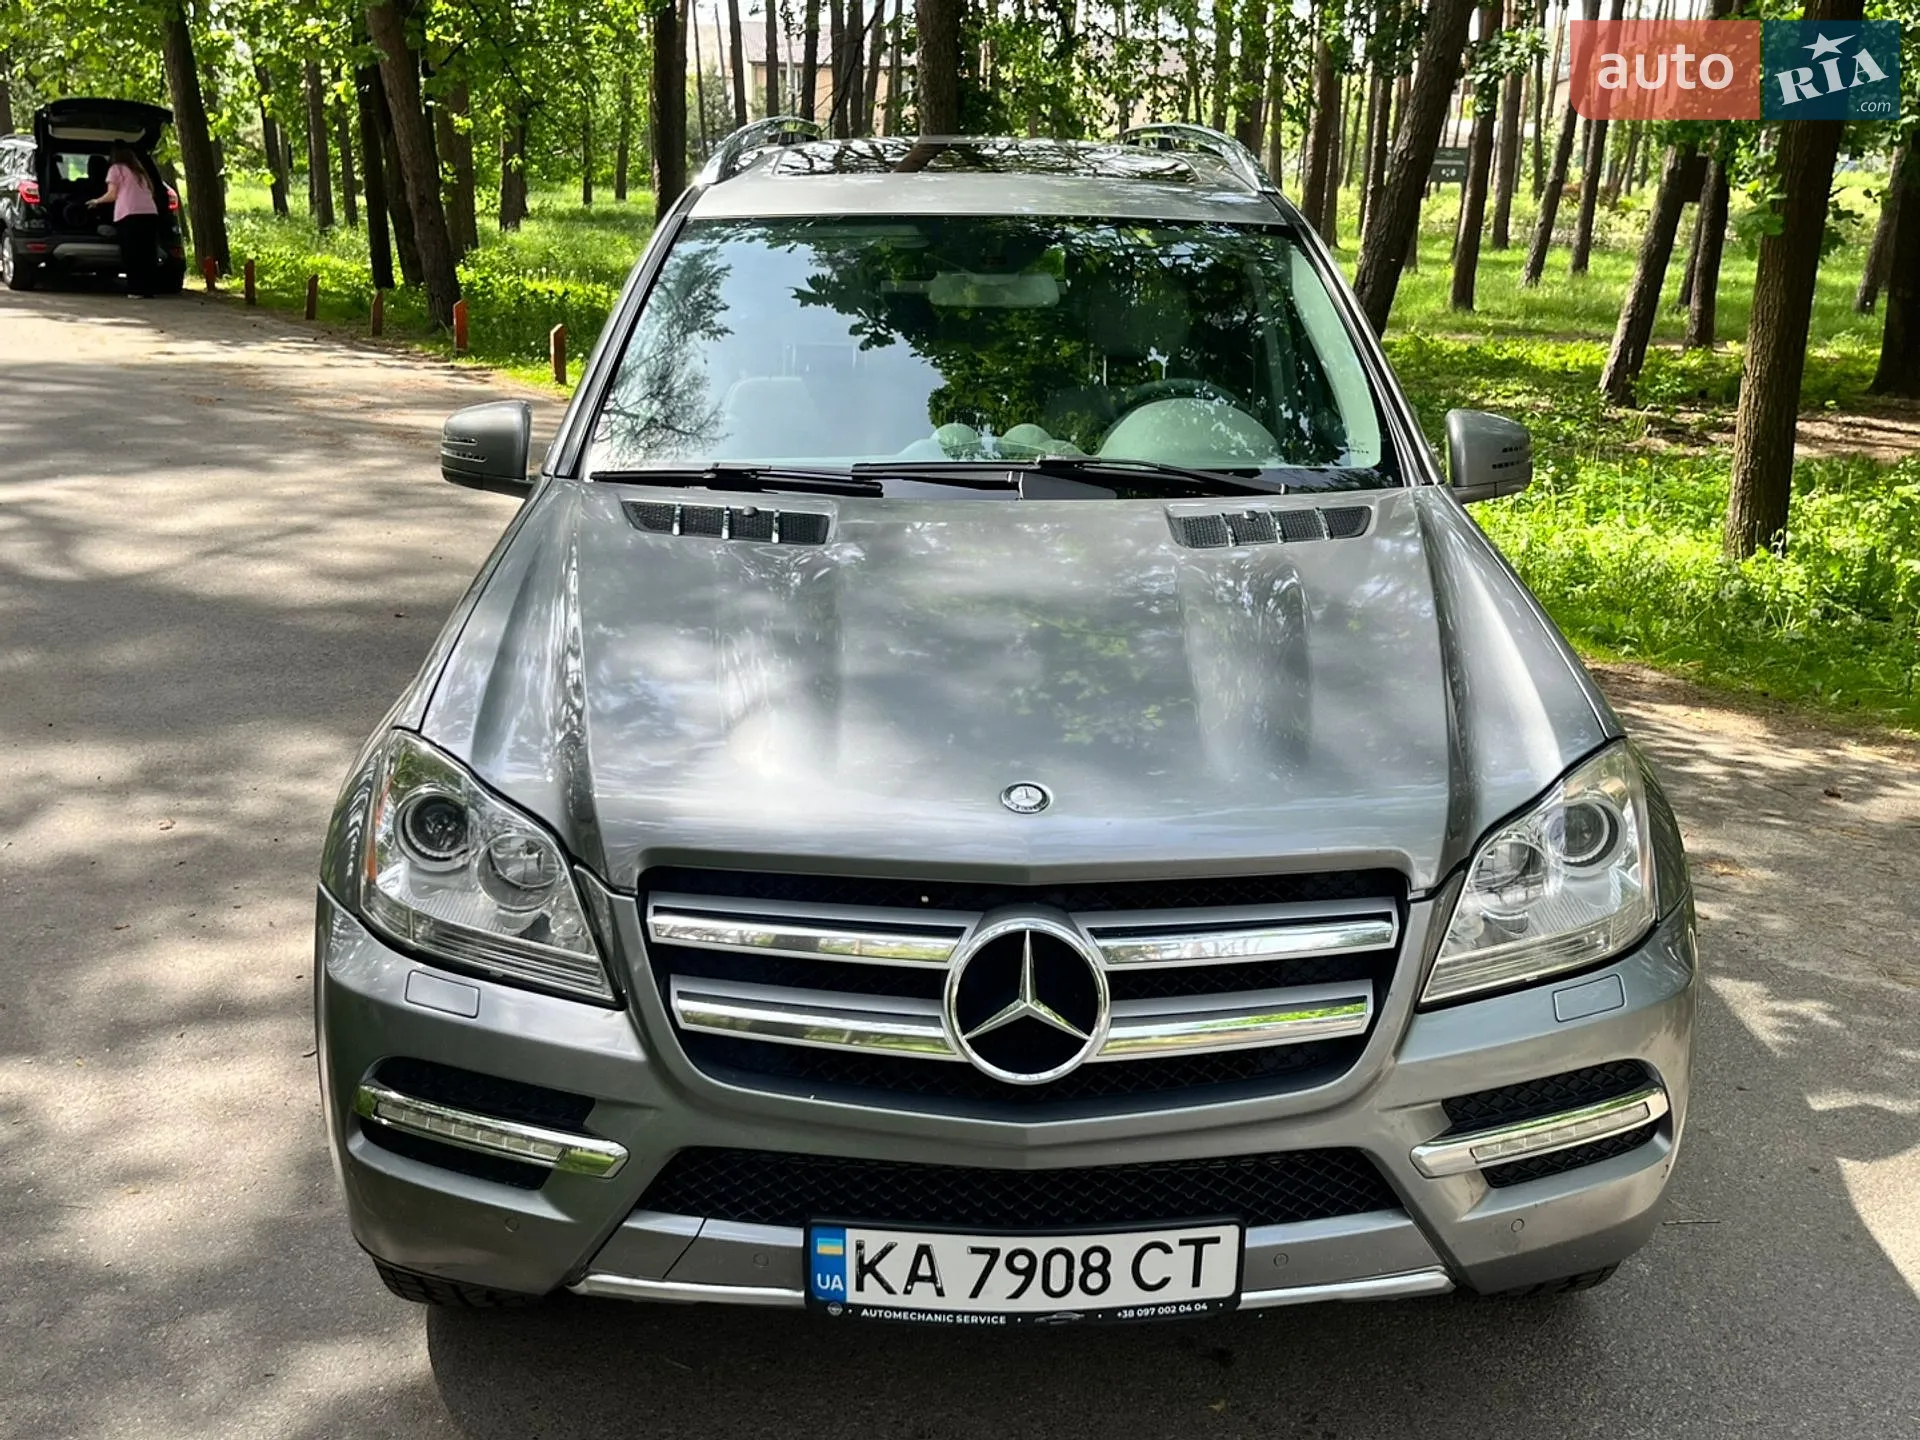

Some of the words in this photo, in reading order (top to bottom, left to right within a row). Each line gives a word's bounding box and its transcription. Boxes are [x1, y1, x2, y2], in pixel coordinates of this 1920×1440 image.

[855, 1240, 945, 1297] KA
[966, 1245, 1112, 1300] 7908
[1131, 1236, 1221, 1292] CT
[817, 1273, 844, 1291] UA
[861, 1308, 954, 1324] AUTOMECHANIC
[955, 1314, 1007, 1325] SERVICE
[1117, 1308, 1135, 1319] +38
[1136, 1307, 1155, 1317] 097
[1157, 1305, 1177, 1315] 002
[1178, 1303, 1192, 1313] 04
[1194, 1302, 1208, 1312] 04
